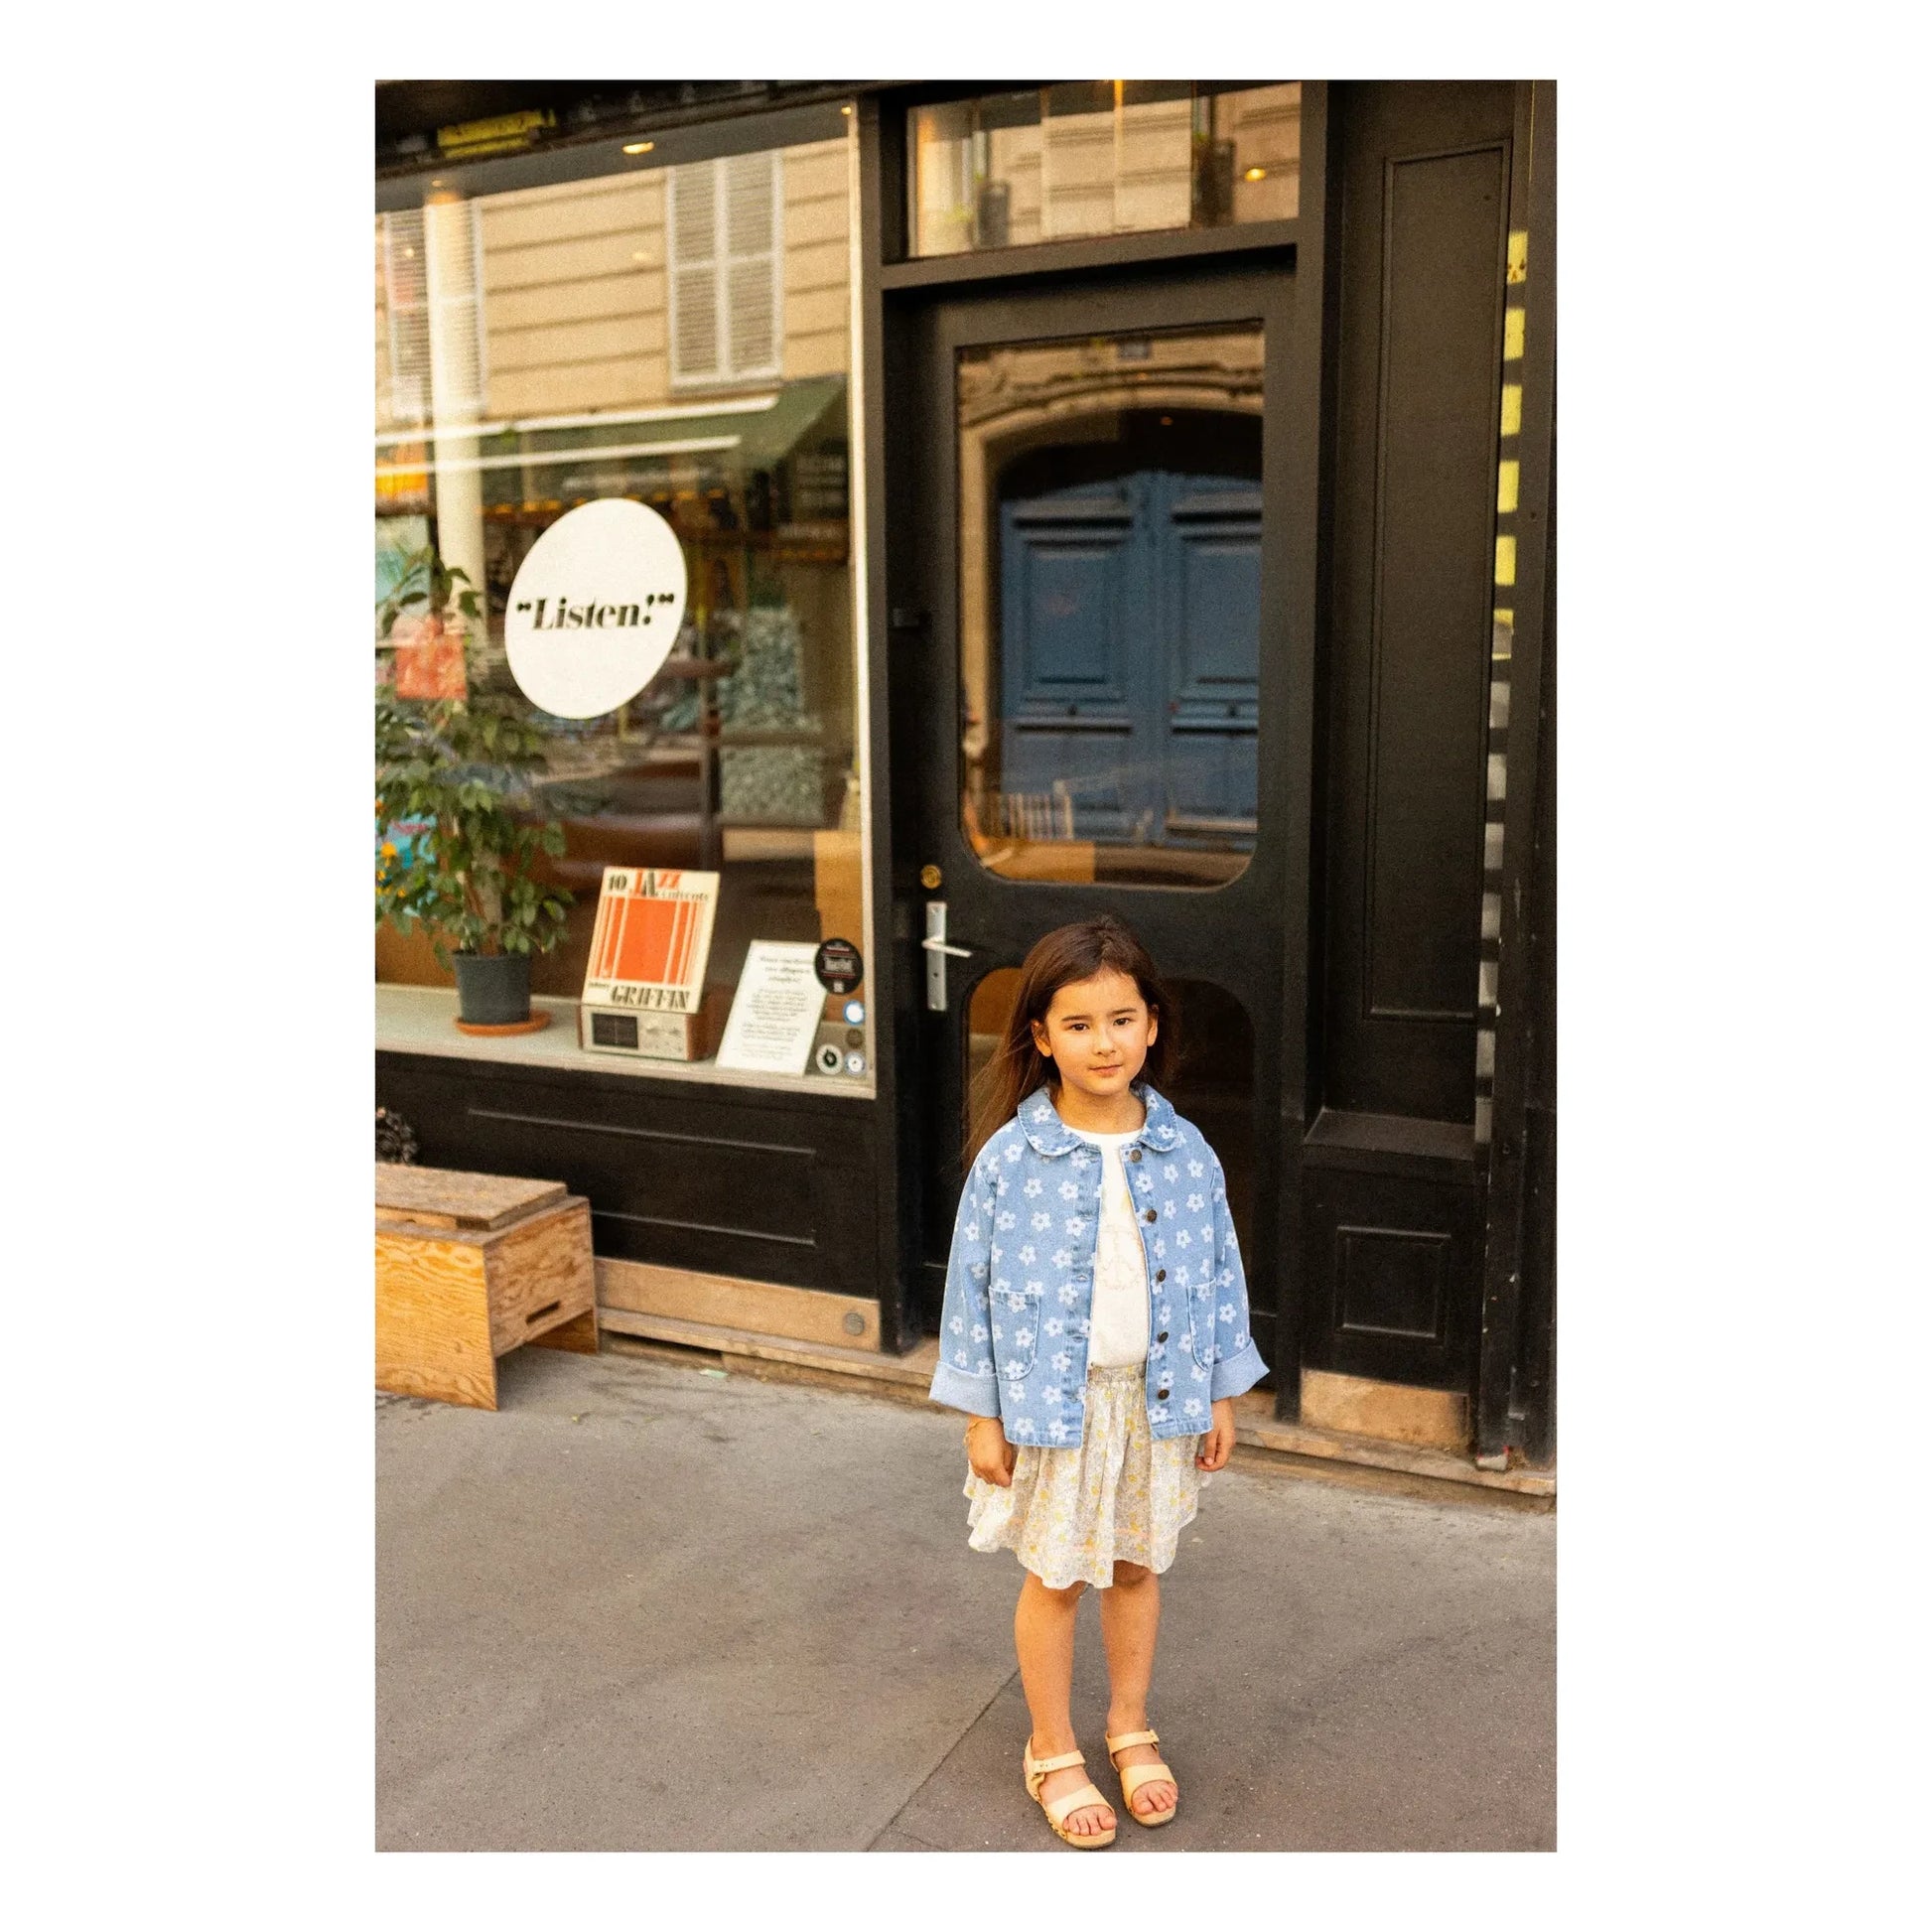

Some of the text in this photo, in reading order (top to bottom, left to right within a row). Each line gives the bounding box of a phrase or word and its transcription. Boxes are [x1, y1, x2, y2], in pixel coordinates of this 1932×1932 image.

[609, 875, 627, 891] 10
[628, 868, 682, 897] JAZZ
[611, 985, 690, 1010] GRIFFIN
